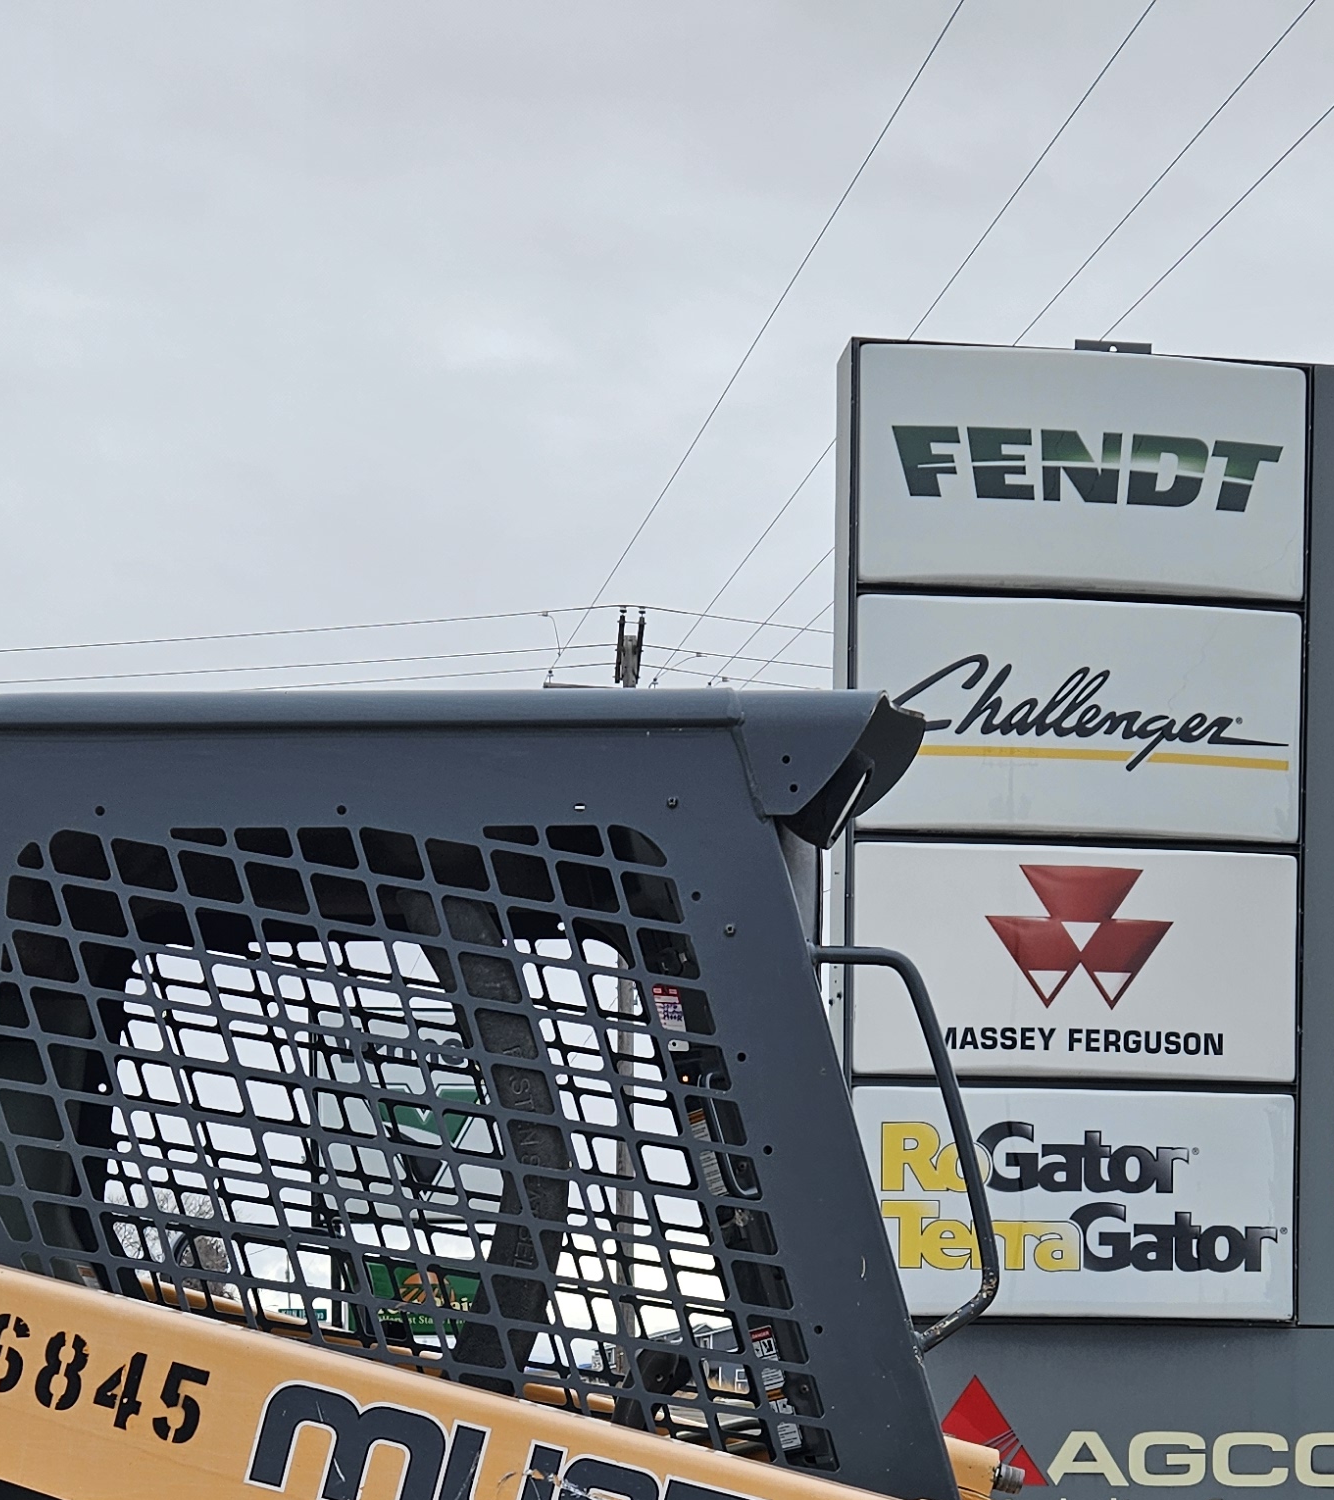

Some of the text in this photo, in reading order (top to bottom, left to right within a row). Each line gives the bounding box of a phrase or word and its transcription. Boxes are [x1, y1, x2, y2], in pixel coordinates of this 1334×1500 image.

[892, 425, 1283, 512] FENDT
[892, 653, 1289, 771] Challenger
[1068, 1028, 1224, 1056] FERGUSON
[881, 1120, 1190, 1193] RoGator
